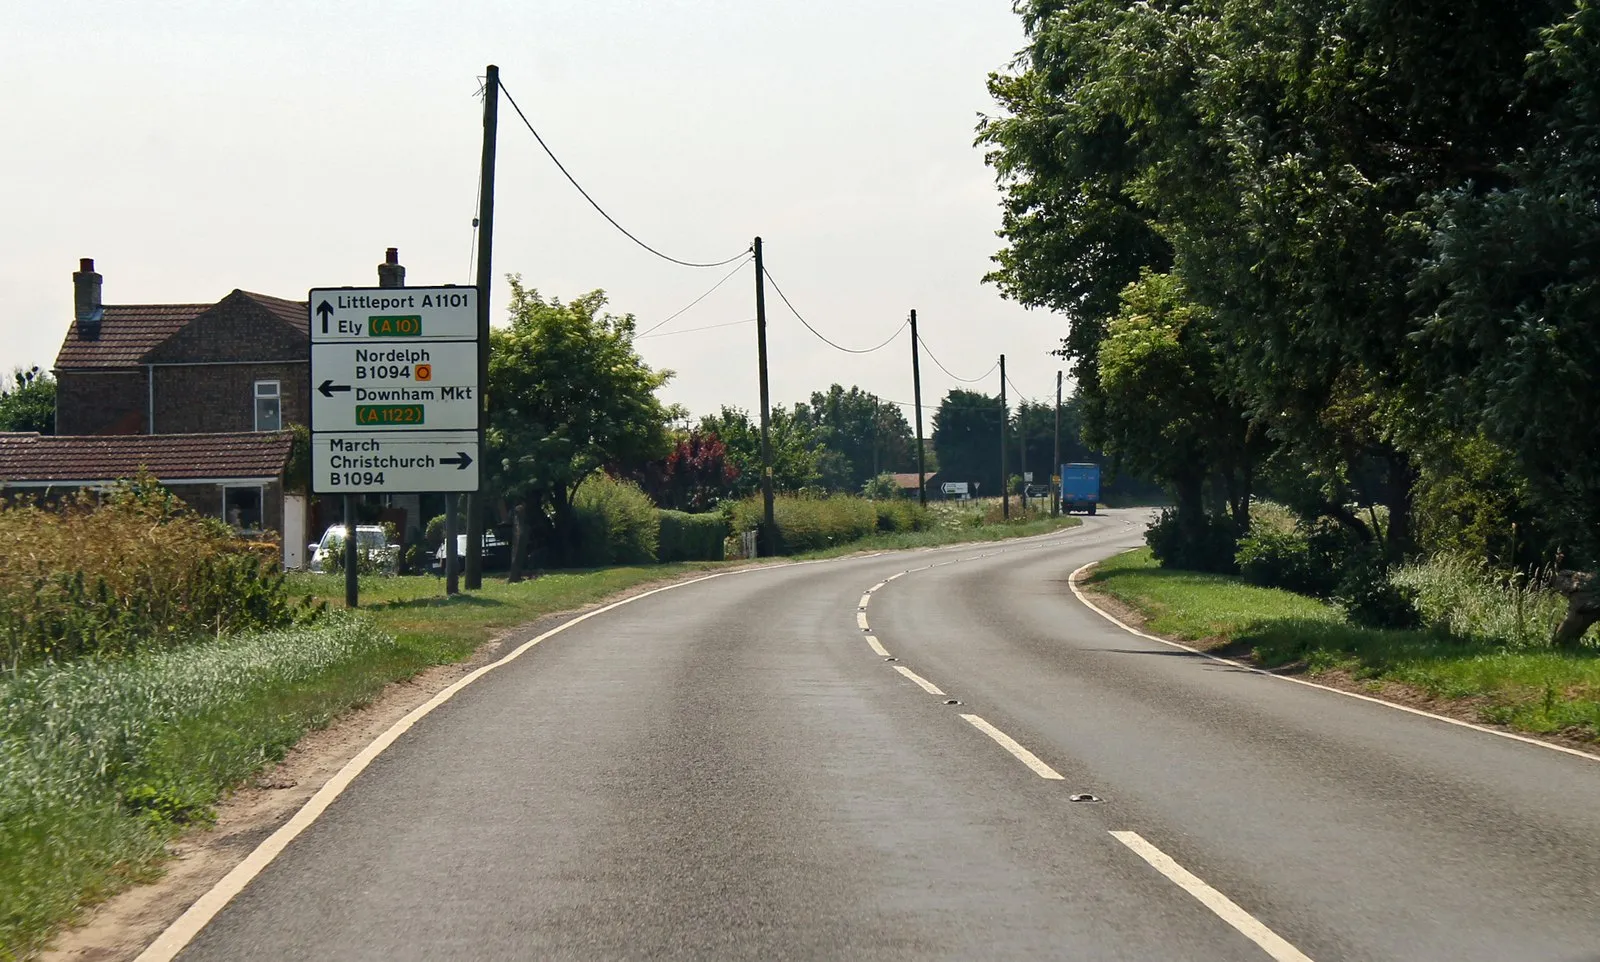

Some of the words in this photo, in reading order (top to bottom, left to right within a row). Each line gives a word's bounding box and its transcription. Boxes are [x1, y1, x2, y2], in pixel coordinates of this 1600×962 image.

[338, 295, 414, 311] Littleport
[422, 294, 468, 307] A1101
[338, 320, 362, 335] Ely
[356, 349, 430, 364] Nordelph
[356, 366, 410, 378] B1094
[356, 388, 434, 401] Downham
[441, 387, 472, 400] Mkt
[330, 439, 379, 451] March
[330, 455, 434, 468] Christchurch
[331, 472, 384, 485] B1094
